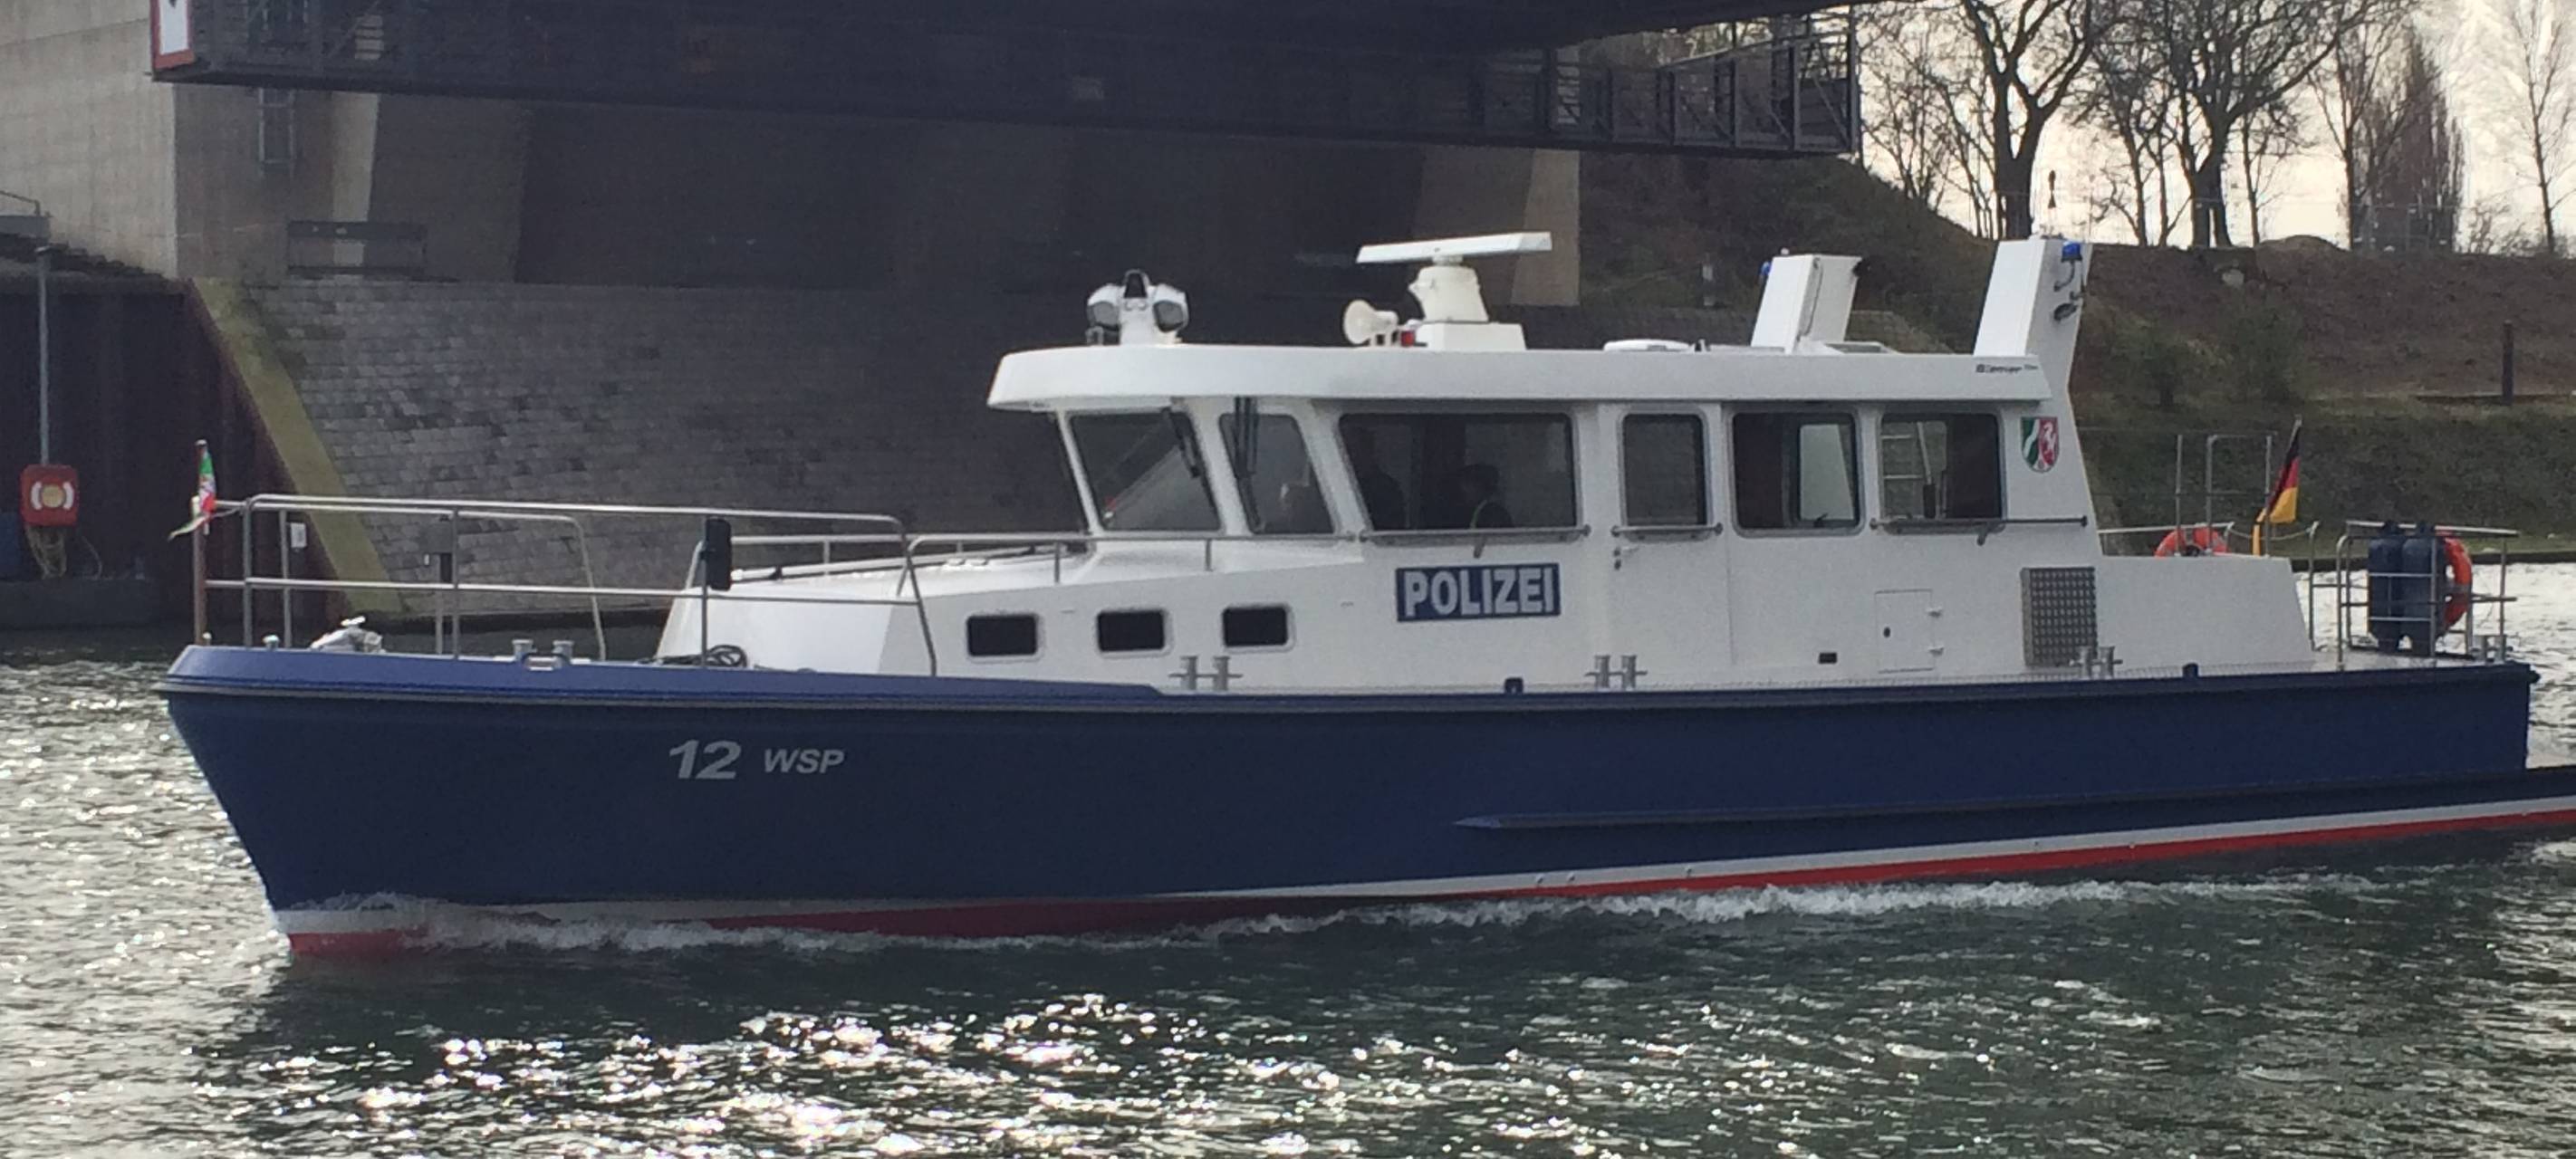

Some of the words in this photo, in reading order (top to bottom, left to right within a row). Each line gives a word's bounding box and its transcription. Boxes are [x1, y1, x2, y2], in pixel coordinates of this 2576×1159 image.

[1404, 568, 1554, 617] POLIZEI
[668, 739, 742, 780] 12
[764, 748, 845, 773] WSP
